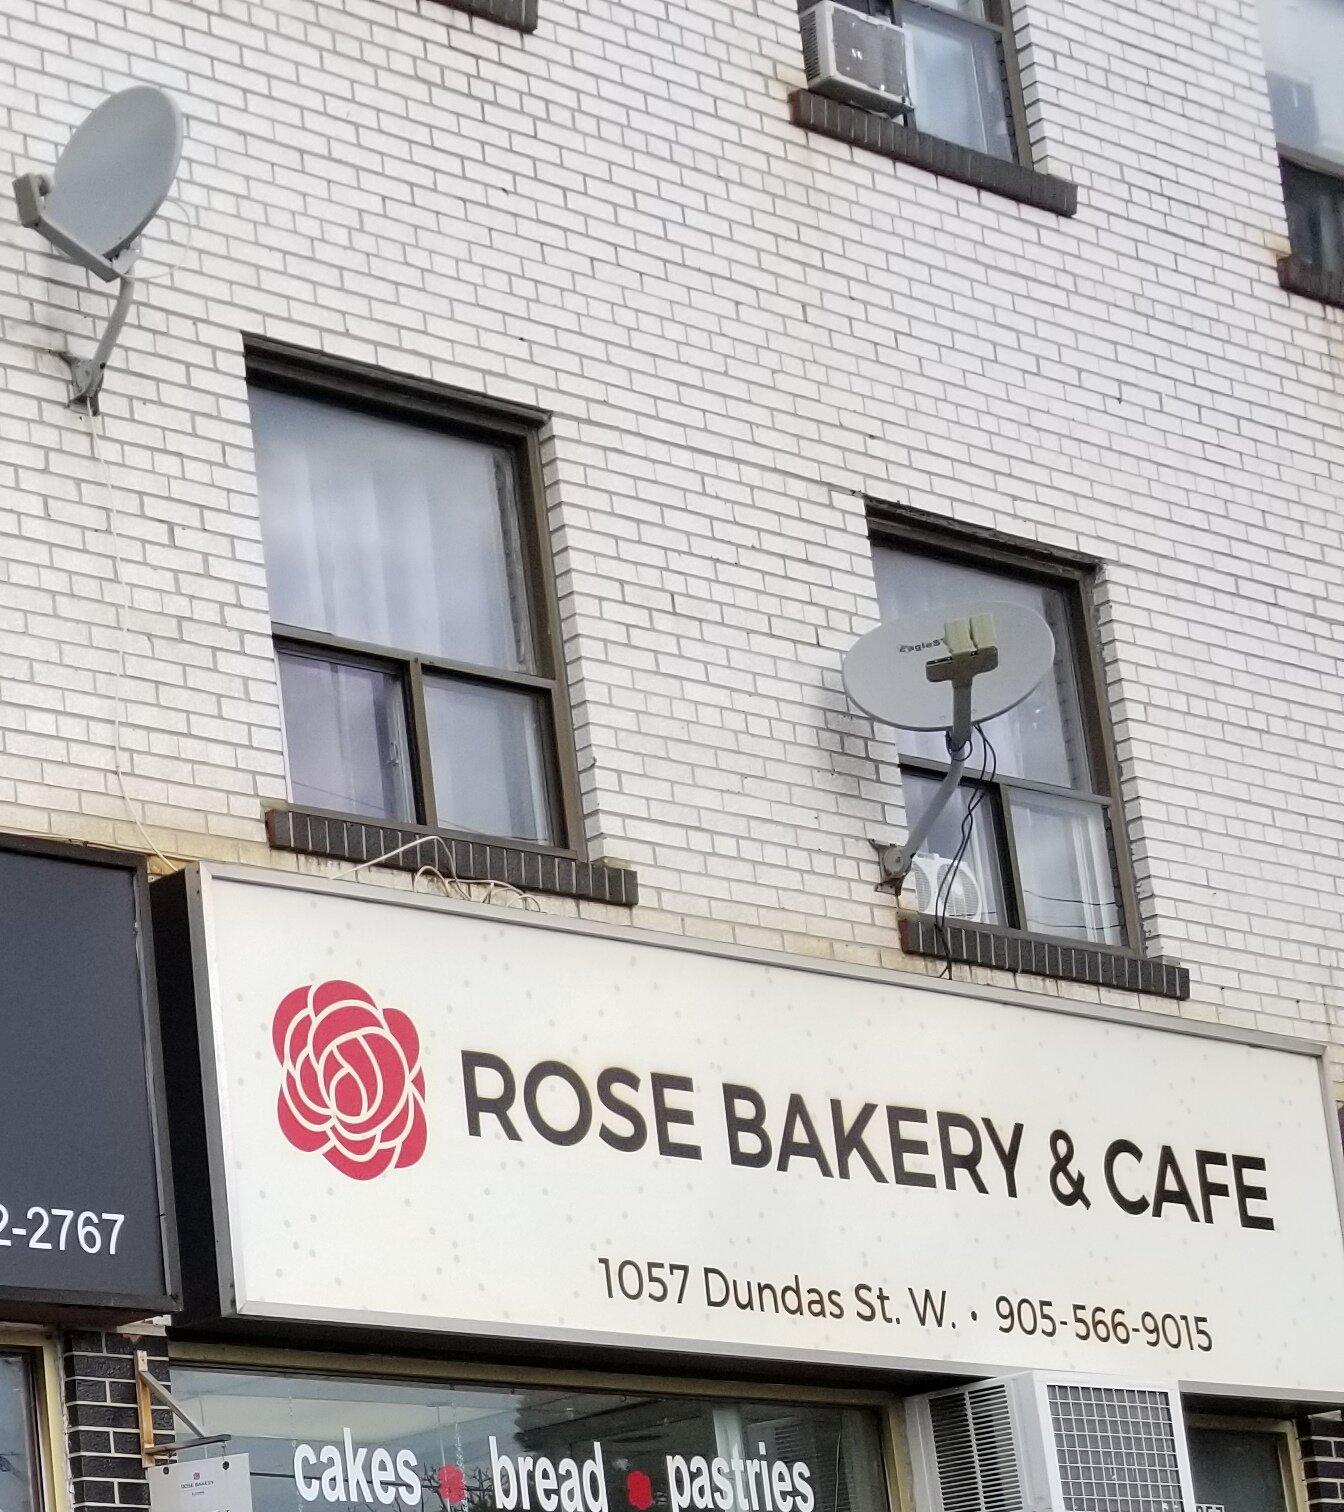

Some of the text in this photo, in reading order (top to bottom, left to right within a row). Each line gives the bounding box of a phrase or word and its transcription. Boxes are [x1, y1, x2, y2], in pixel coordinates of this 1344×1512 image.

[899, 638, 944, 653] EagleS
[460, 1049, 1275, 1231] ROSE BAKERY & CAFE
[597, 1255, 1213, 1352] 1057 Dundas St. W. 905-566-9015
[293, 1427, 423, 1505] cakes
